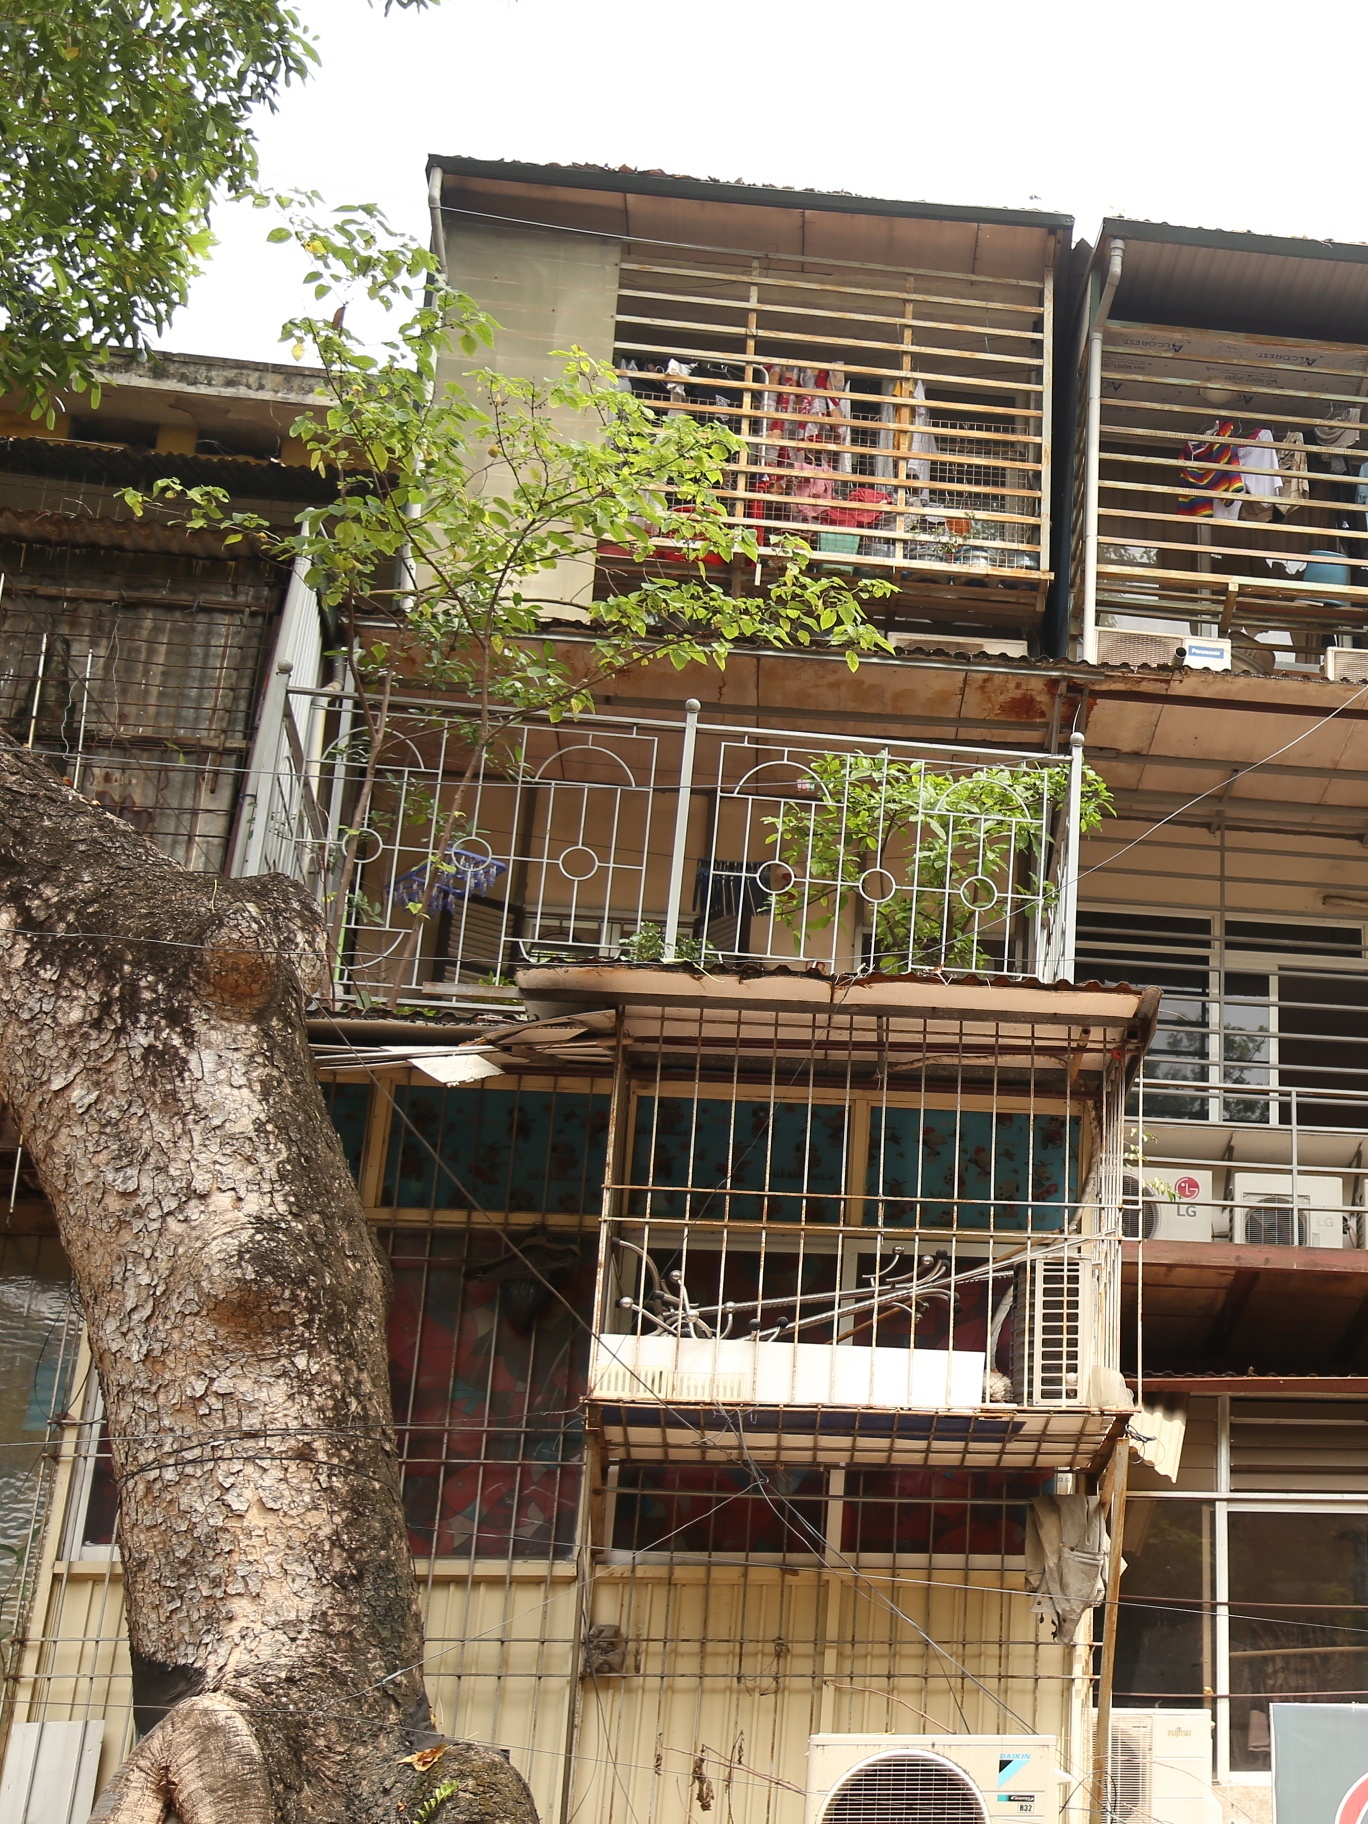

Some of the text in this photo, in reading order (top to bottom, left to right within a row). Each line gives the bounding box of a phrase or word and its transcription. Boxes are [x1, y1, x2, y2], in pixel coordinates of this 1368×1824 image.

[1191, 648, 1221, 656] Panasonic
[1177, 1204, 1197, 1217] LG
[1019, 1804, 1033, 1812] R32
